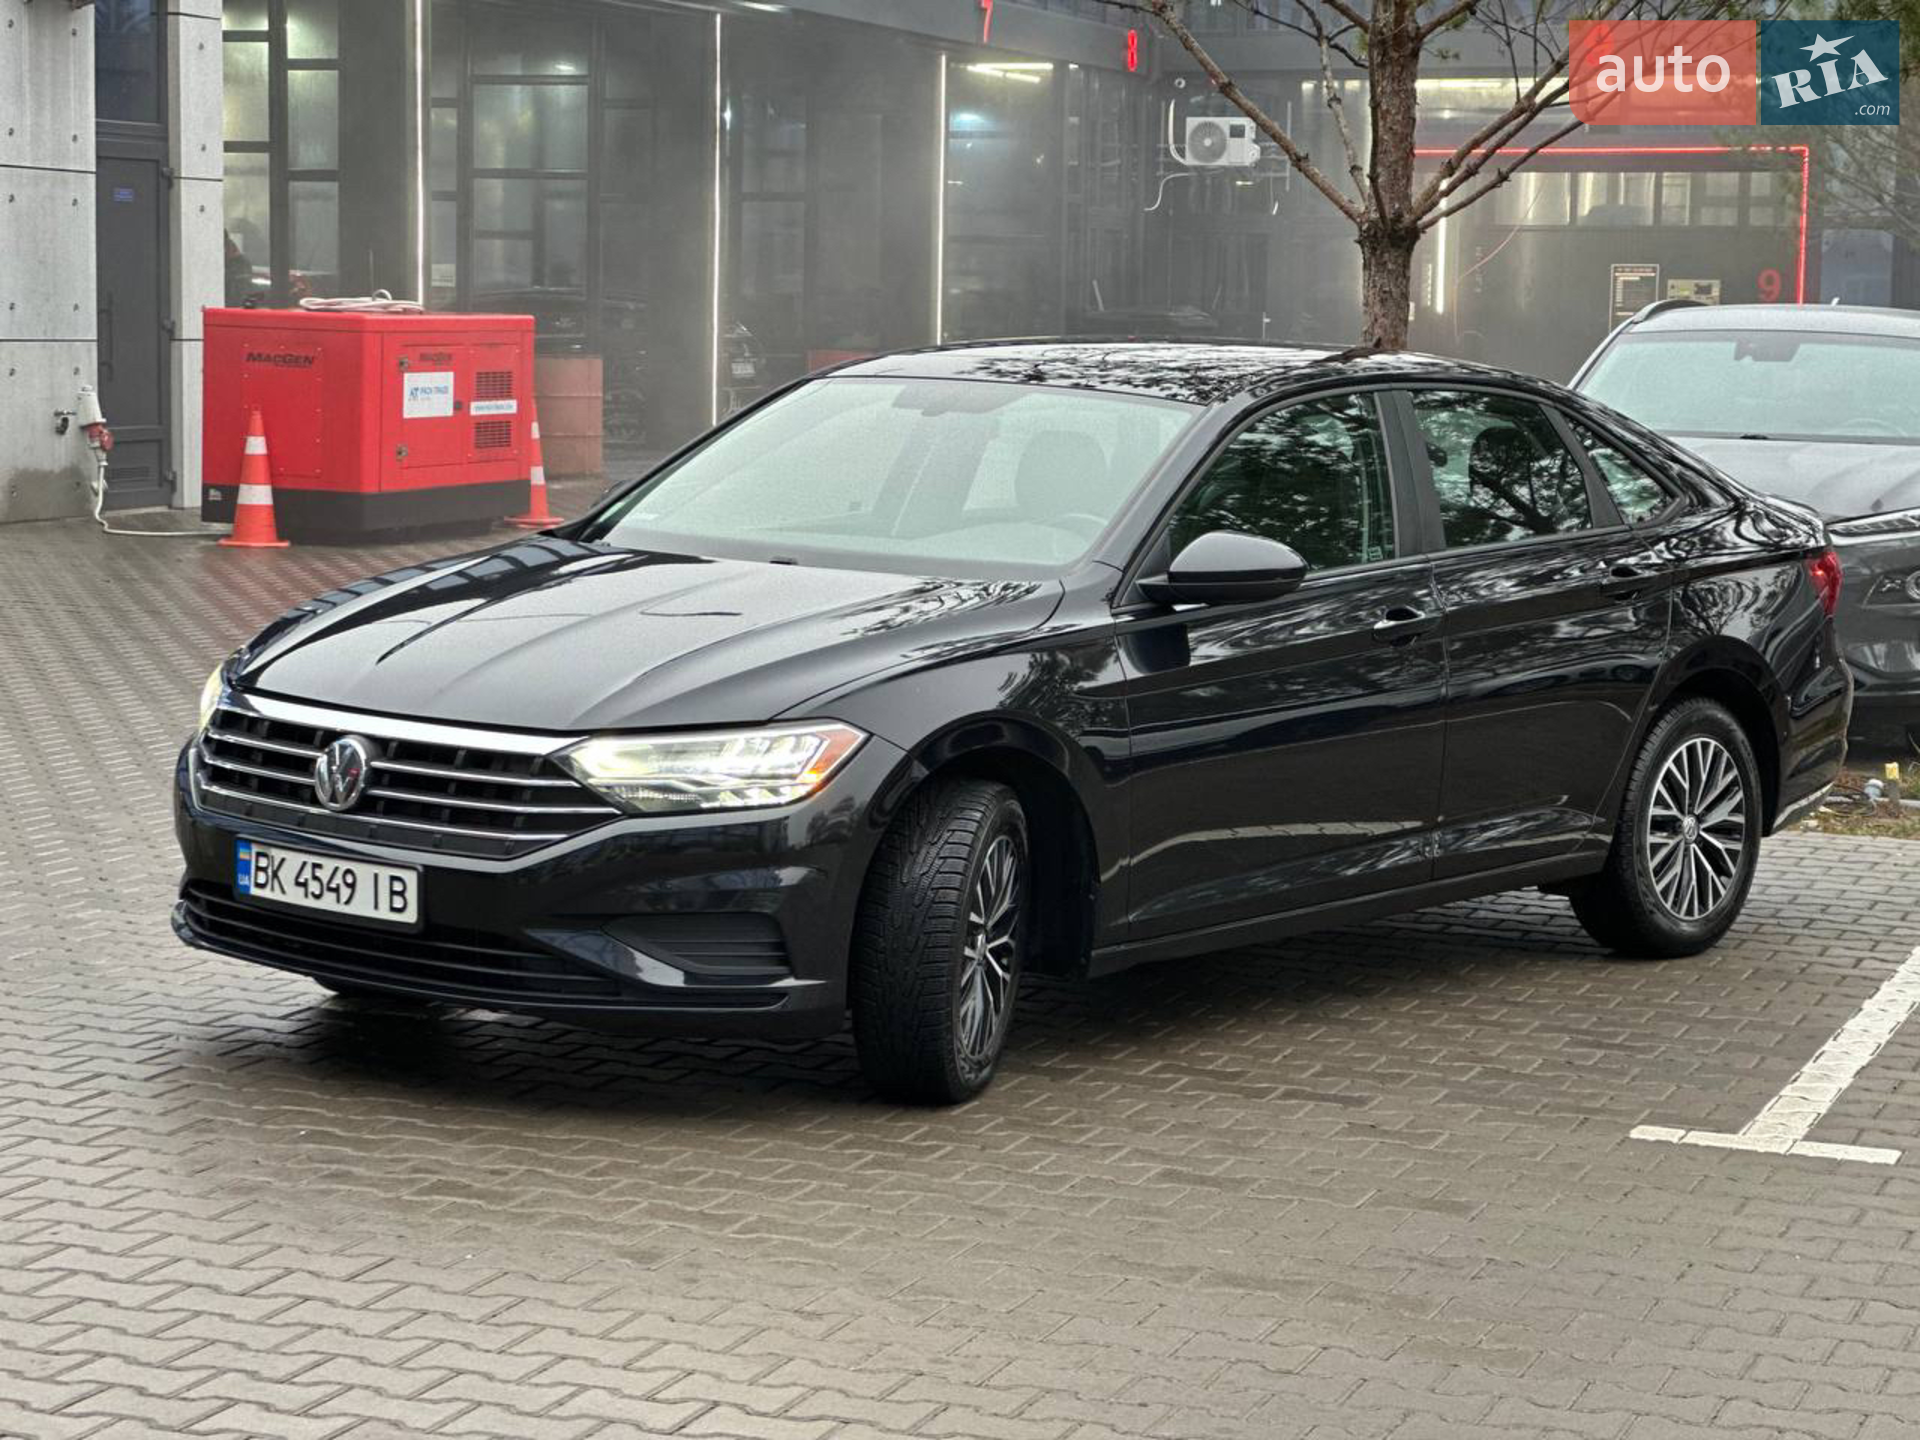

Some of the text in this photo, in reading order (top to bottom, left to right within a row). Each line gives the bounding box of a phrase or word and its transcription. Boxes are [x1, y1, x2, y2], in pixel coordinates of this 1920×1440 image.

[1127, 29, 1138, 73] 8
[1757, 268, 1782, 303] 9
[254, 851, 286, 895] BK
[294, 860, 357, 906] 4549
